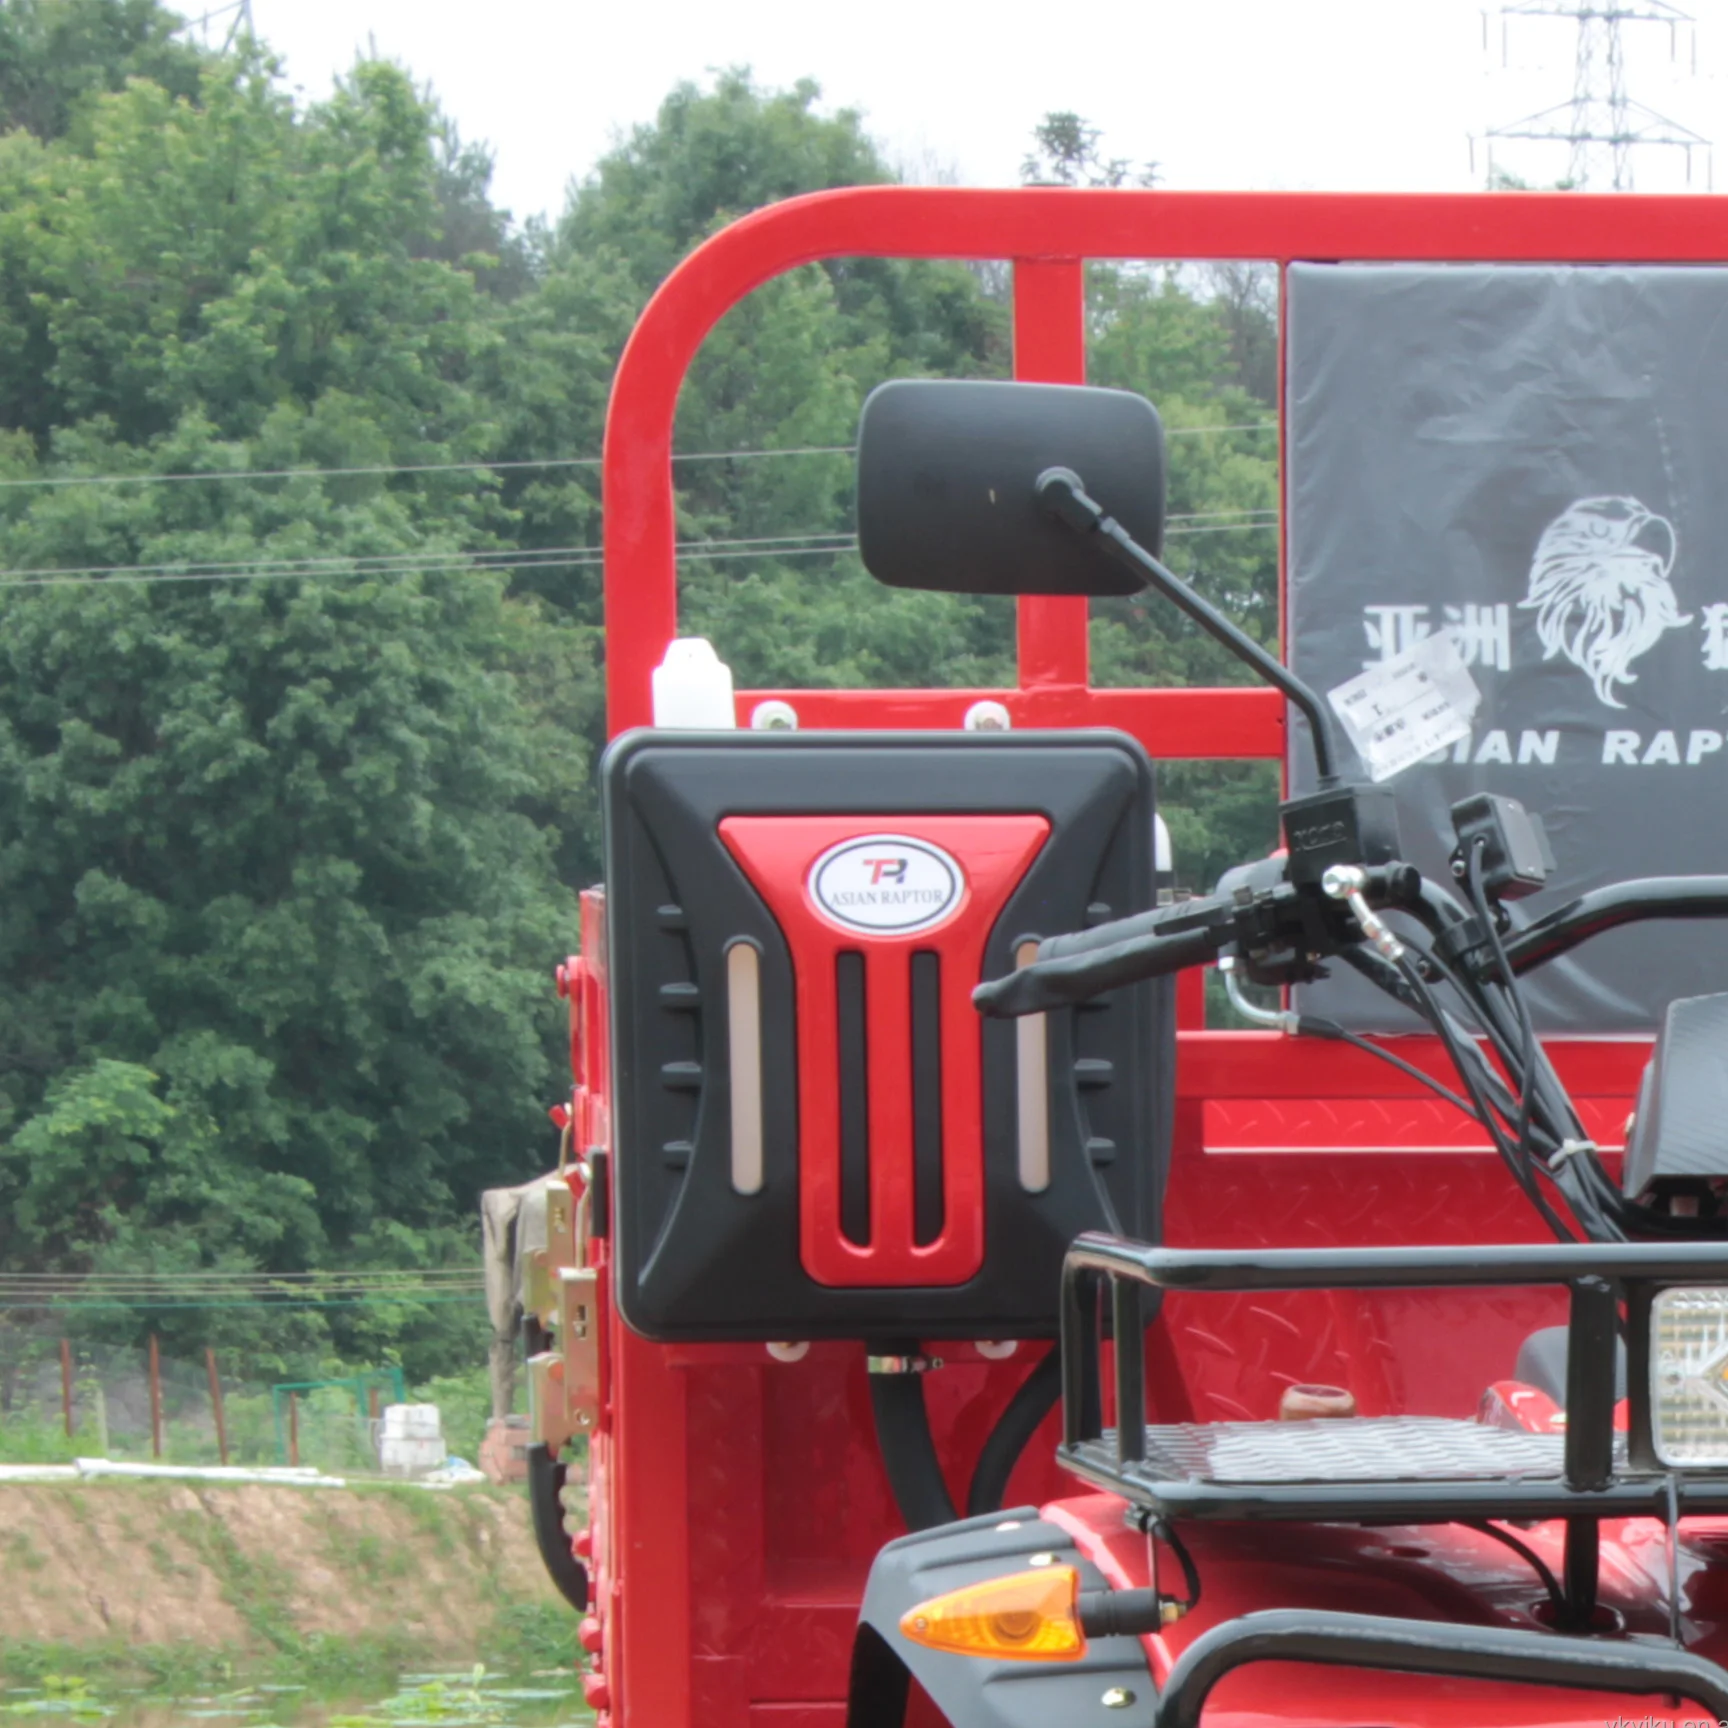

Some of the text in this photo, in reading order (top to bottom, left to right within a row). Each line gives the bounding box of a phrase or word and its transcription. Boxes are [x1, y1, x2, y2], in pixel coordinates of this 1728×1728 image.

[1363, 603, 1510, 671] 亚洲
[832, 889, 944, 906] ASIAN RAPTOR
